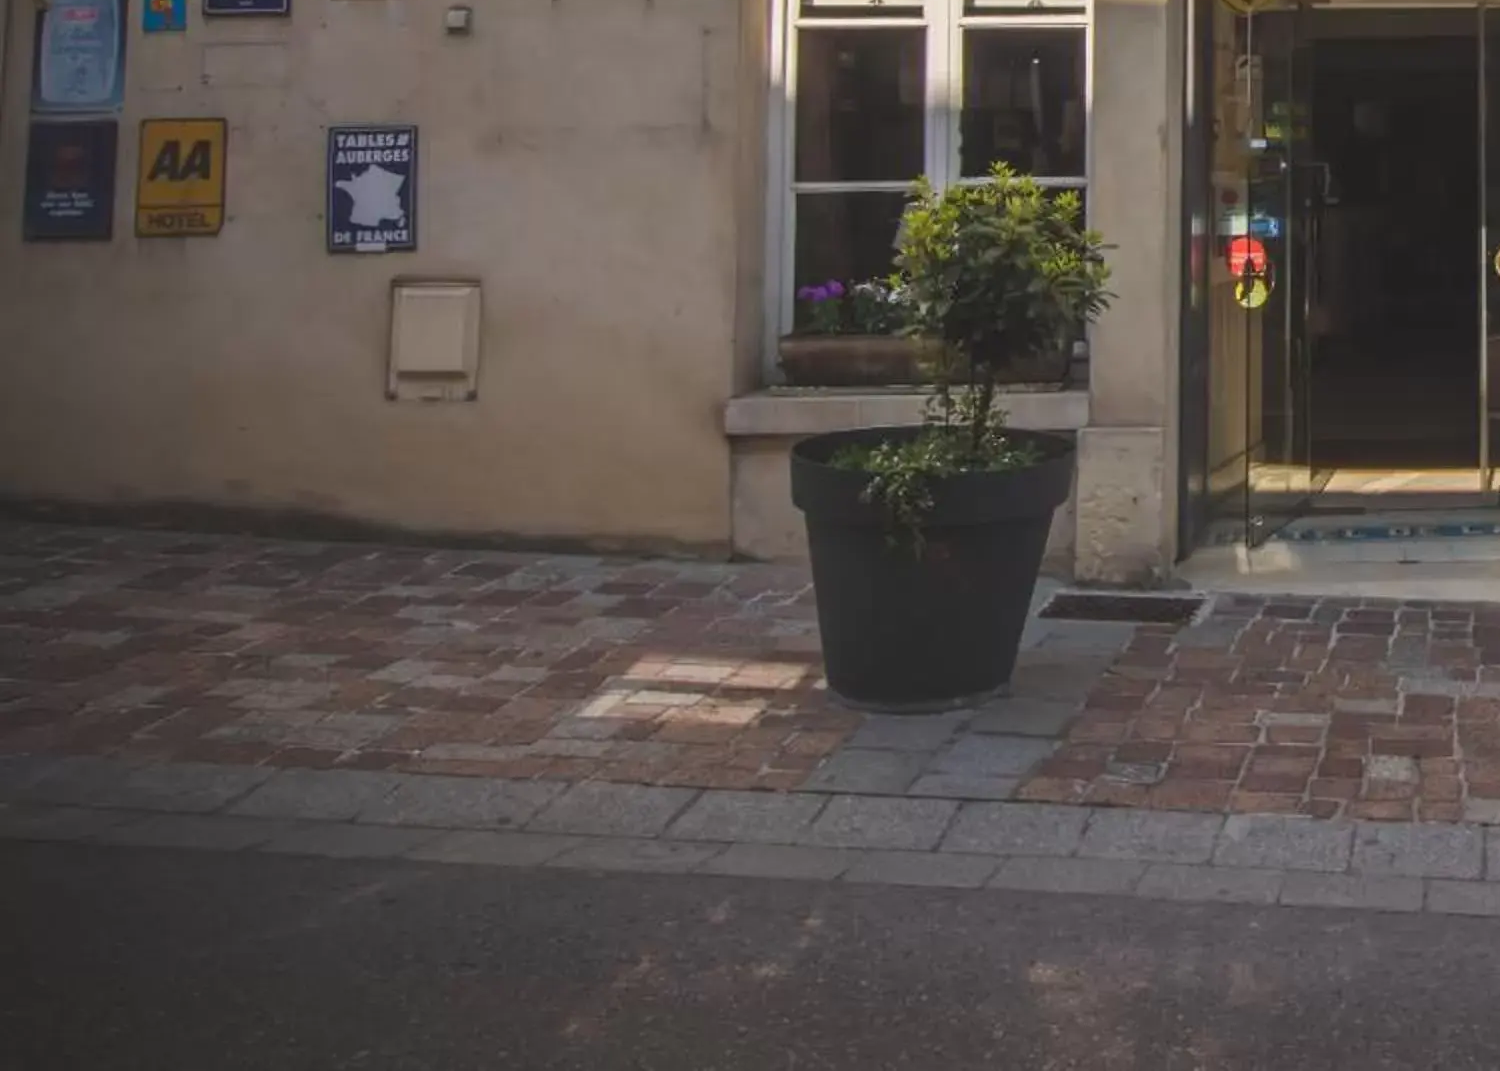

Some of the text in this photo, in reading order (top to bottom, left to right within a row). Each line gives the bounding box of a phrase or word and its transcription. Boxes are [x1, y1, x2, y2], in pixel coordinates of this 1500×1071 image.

[336, 133, 395, 147] TABLES
[147, 140, 212, 182] AA
[336, 148, 410, 164] AUBERGES
[147, 212, 212, 228] HOTEL
[334, 230, 409, 244] DE FRANCE
